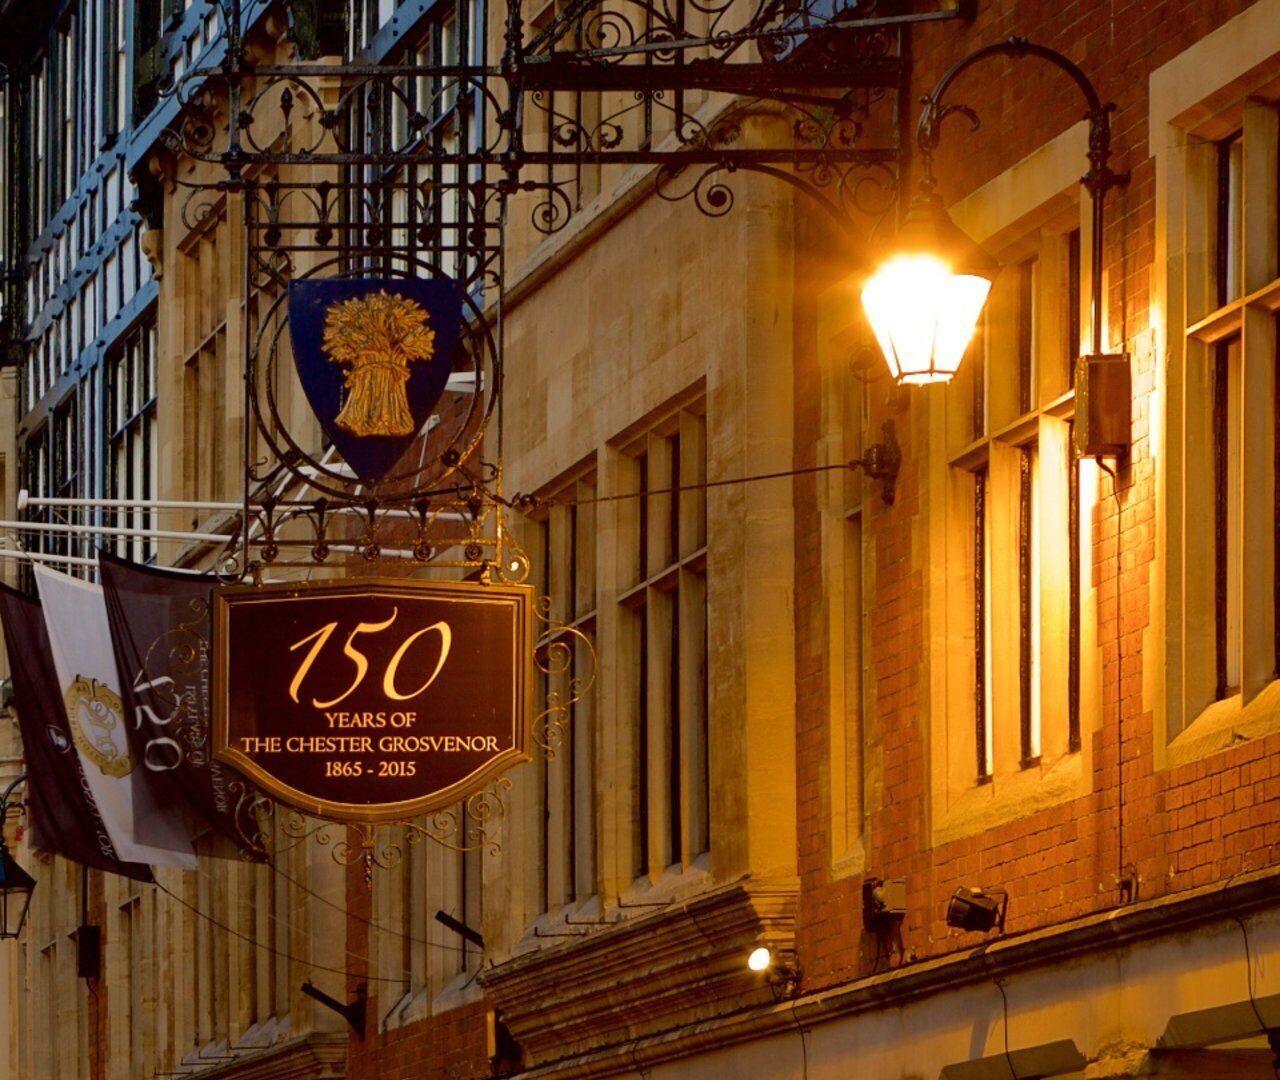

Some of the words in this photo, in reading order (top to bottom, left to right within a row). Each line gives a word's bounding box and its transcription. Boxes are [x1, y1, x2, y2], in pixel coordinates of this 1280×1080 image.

[289, 606, 452, 709] 150
[324, 712, 386, 728] YEARS
[390, 712, 417, 728] OF
[241, 737, 282, 753] THE
[286, 737, 374, 753] CHESTER
[379, 735, 500, 752] GROSVENOR
[325, 761, 362, 777] 1865
[378, 761, 416, 777] 2015
